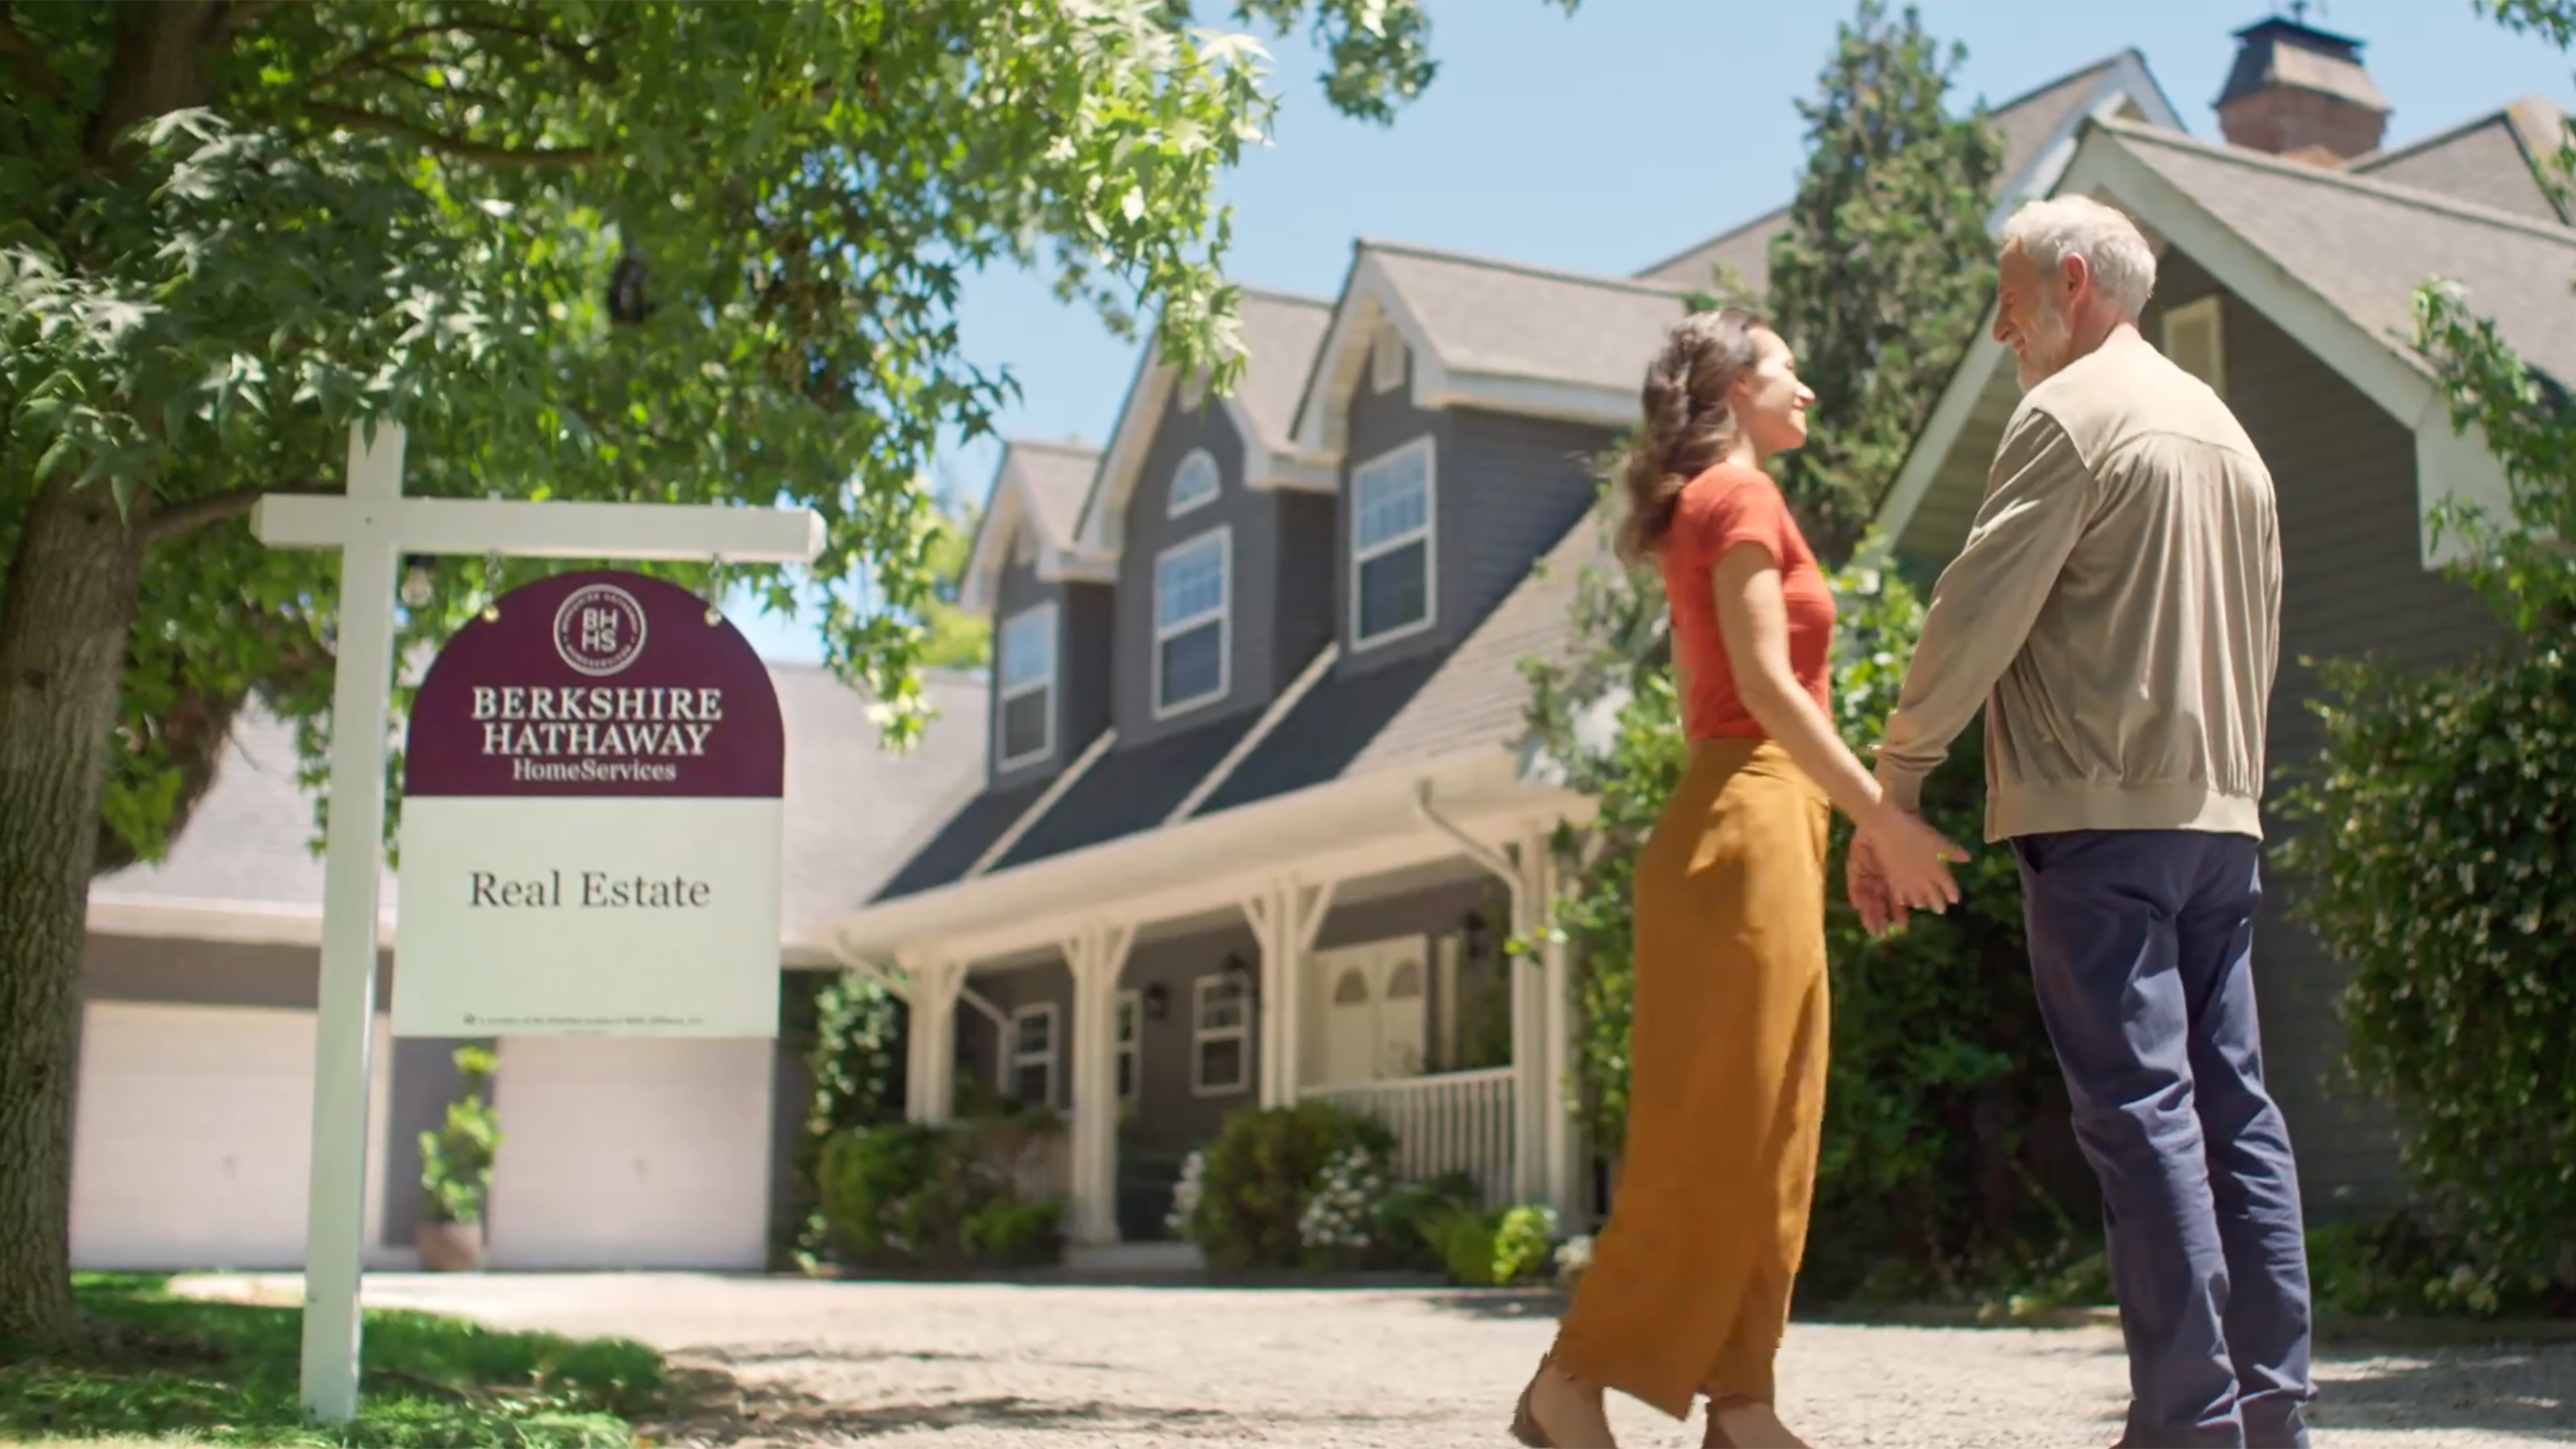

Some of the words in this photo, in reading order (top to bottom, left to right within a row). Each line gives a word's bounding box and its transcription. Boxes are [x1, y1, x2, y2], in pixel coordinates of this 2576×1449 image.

[583, 607, 618, 630] BH
[581, 628, 617, 653] HS
[471, 686, 723, 720] BERKSHIRE
[481, 722, 712, 755] HATHAWAY
[513, 758, 677, 781] HomeServices
[469, 869, 561, 907] Real
[580, 870, 711, 908] Estate
